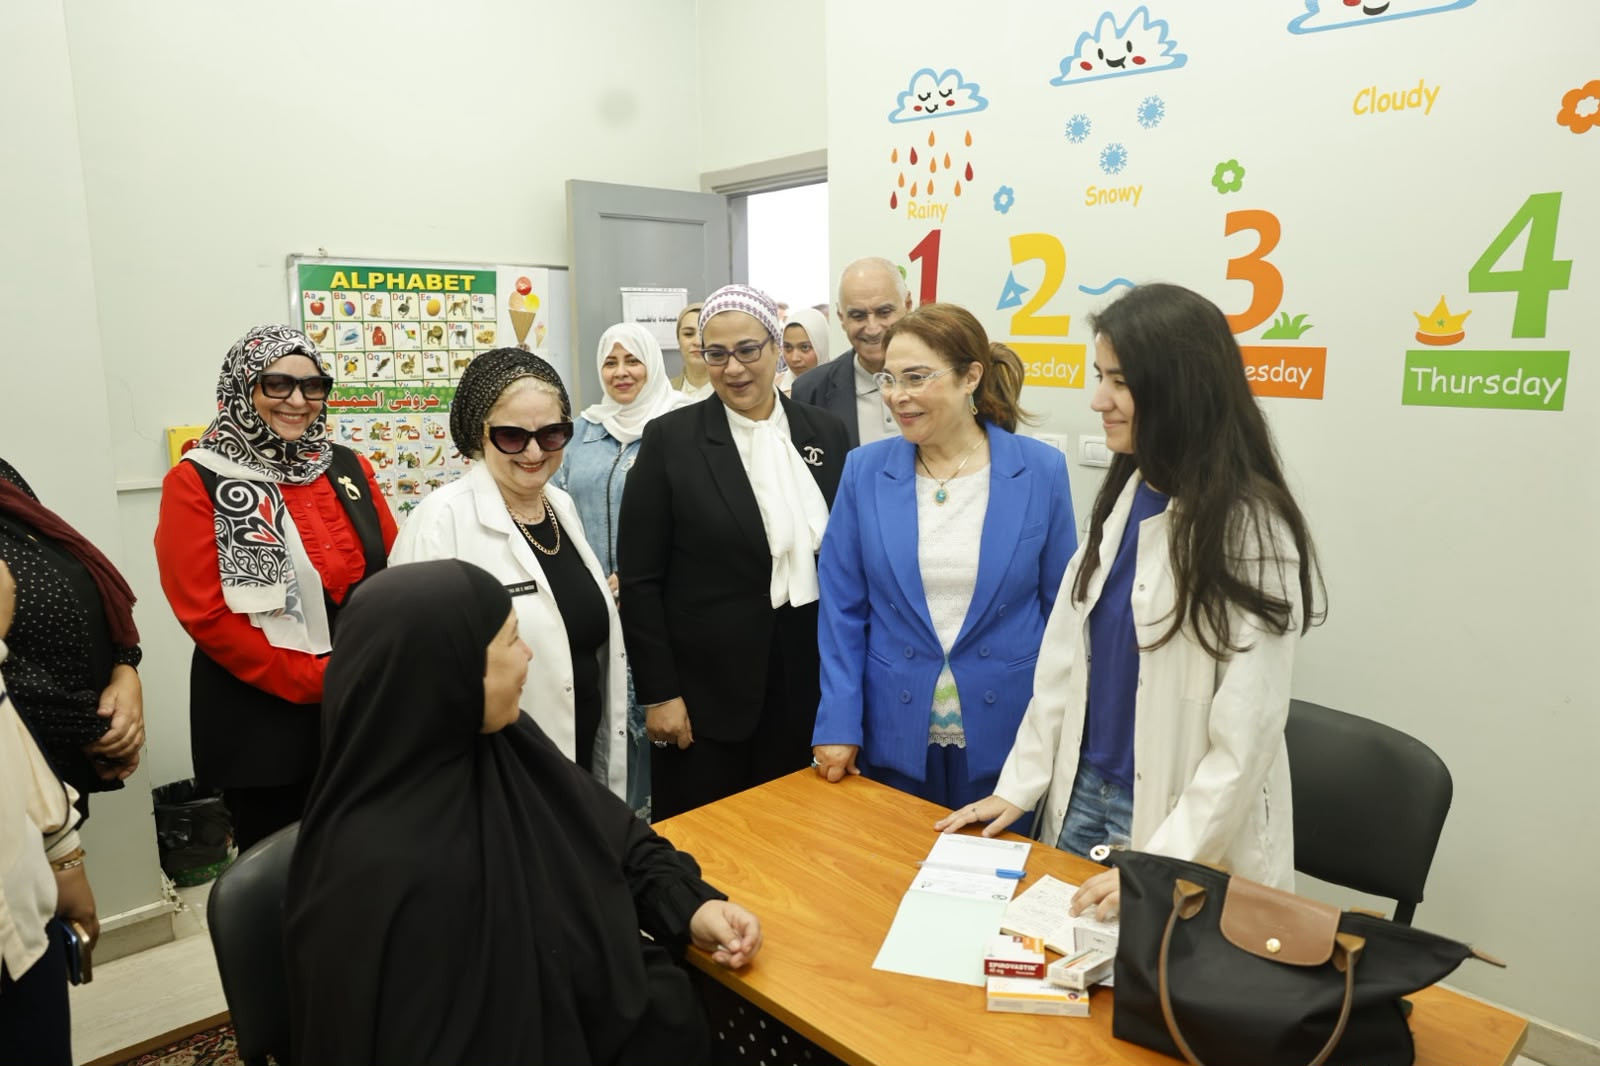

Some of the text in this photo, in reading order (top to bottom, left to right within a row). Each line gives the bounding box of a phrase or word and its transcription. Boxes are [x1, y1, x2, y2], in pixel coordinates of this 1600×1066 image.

[1353, 79, 1441, 115] Cloudy
[907, 200, 949, 222] Rainy
[1085, 185, 1144, 206] Snowy
[330, 271, 476, 291] ALPHABET
[1223, 209, 1284, 335] 3
[1469, 191, 1573, 338] 4
[1009, 232, 1071, 337] 2
[1023, 356, 1080, 384] esday
[1244, 359, 1312, 390] esday
[1410, 367, 1563, 404] Thursday
